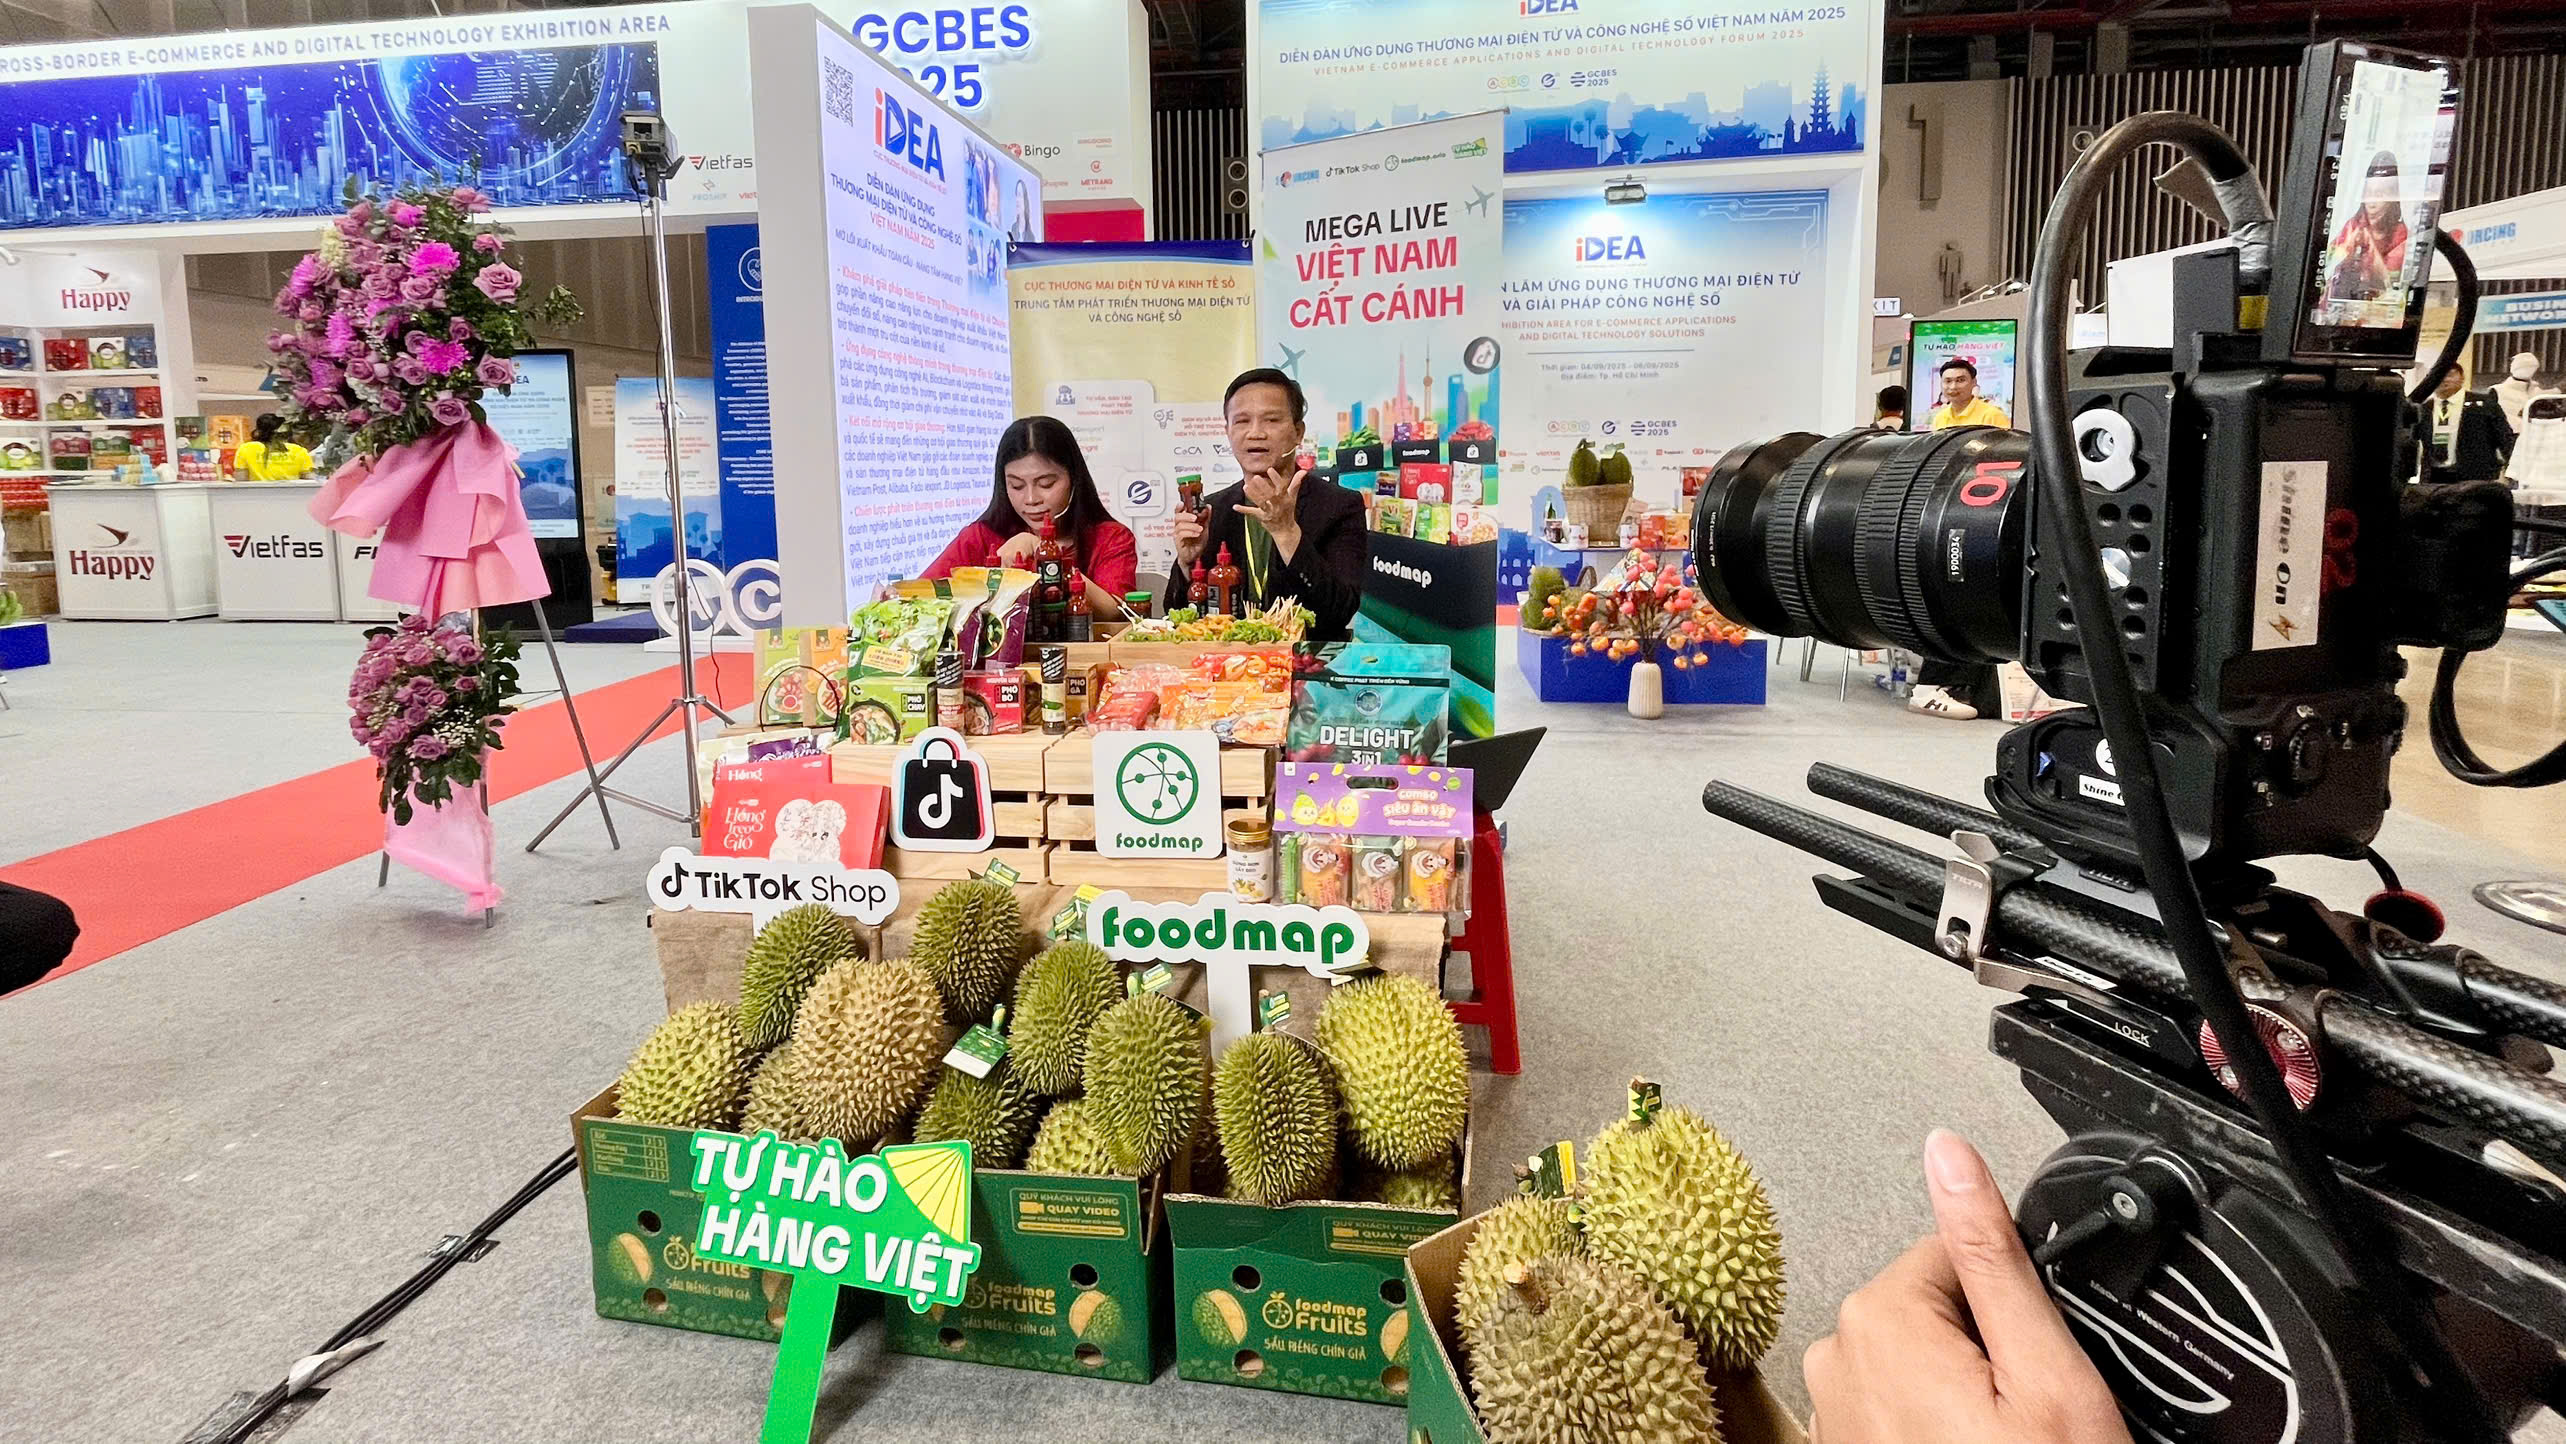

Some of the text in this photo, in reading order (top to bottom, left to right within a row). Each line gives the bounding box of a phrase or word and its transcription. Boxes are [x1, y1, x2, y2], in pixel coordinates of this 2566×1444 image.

[128, 42, 245, 65] E-COMMERCE
[252, 40, 288, 57] AND
[294, 33, 364, 55] DIGITAL
[370, 25, 496, 49] TECHNOLOGY
[501, 18, 613, 41] EXHIBITION
[619, 14, 671, 33] AREA
[852, 5, 1030, 53] GCBES
[1376, 42, 1414, 58] DỤNG
[1416, 36, 1475, 53] THƯƠNG
[1477, 35, 1503, 50] MẠI
[1506, 31, 1540, 47] ĐIỆN
[1565, 27, 1584, 40] VÀ
[1586, 24, 1627, 39] CÔNG
[1630, 20, 1671, 36] NGHỆ
[1674, 15, 1694, 32] SỐ
[1697, 14, 1729, 31] VIỆT
[1732, 13, 1766, 28] NAM
[1770, 8, 1805, 24] NĂM
[1807, 6, 1846, 21] 2025
[1313, 29, 1805, 76] VIETNAM E-COMMERCE APPLICATIONS AND DIGITAL TECHNOLOGY FORUM 2025
[1587, 69, 1617, 78] GCBES
[1587, 78, 1609, 87] 2025
[875, 87, 945, 183] iDEA
[1024, 144, 1061, 159] Bingo
[1334, 166, 1360, 176] TikTok
[1305, 202, 1448, 243] MEGA LIVE
[1296, 236, 1457, 286] VIỆT NAM
[1575, 236, 1647, 262] iDEA
[1024, 281, 1046, 293] CỤC
[1048, 279, 1092, 291] THƯƠNG
[1095, 280, 1114, 292] MẠI
[1178, 279, 1204, 289] KINH
[1206, 275, 1219, 289] TẾ
[1221, 275, 1236, 289] SỐ
[1586, 279, 1628, 294] DỤNG
[1632, 275, 1699, 290] THƯƠNG
[1704, 275, 1732, 291] MẠI
[1736, 272, 1774, 290] ĐIỆN
[61, 288, 131, 312] Happy
[1014, 299, 1050, 310] TRUNG
[1053, 296, 1075, 309] TÂM
[1078, 296, 1105, 309] PHÁT
[1108, 295, 1139, 308] TRIỂN
[1142, 297, 1185, 308] THƯƠNG
[1187, 297, 1207, 310] MẠI
[1289, 283, 1464, 328] CẤT CÁNH
[1503, 290, 1721, 311] VÀ GIẢI PHÁP CÔNG NGHỆ SỐ
[1105, 312, 1134, 323] CÔNG
[1136, 312, 1166, 324] NGHỆ
[1168, 308, 1182, 322] SỐ
[1546, 318, 1572, 329] AREA
[1574, 318, 1594, 328] FOR
[1597, 316, 1662, 328] E-COMMERCE
[1665, 315, 1737, 326] APPLICATIONS
[1519, 328, 1705, 341] AND DIGITAL TECHNOLOGY SOLUTIONS
[1647, 428, 1669, 436] 2025
[1960, 460, 2023, 507] 01
[223, 534, 324, 560] Vietfas
[2275, 469, 2297, 606] Shine On
[70, 549, 155, 581] Happy
[1372, 555, 1433, 589] foodmap
[1319, 725, 1415, 750] DELIGHT
[2083, 782, 2115, 798] Shine
[1116, 832, 1204, 853] foodmap
[694, 871, 886, 911] TikTok Shop
[1102, 906, 1355, 964] foodmap
[2115, 1021, 2150, 1045] LOCK
[694, 1136, 770, 1204] TỰ
[769, 1145, 888, 1213] HÀO
[1046, 1204, 1120, 1217] QUAY VIDEO
[1074, 1195, 1091, 1204] VUI
[1361, 1231, 1398, 1241] QUAY
[700, 1201, 974, 1305] HÀNG VIỆT
[988, 1280, 1056, 1301] foodmap
[989, 1293, 1056, 1316] Fruits
[1295, 1297, 1367, 1321] foodmap
[1295, 1311, 1368, 1337] Fruits
[2136, 1308, 2181, 1343] Western
[2184, 1339, 2236, 1381] Germany
